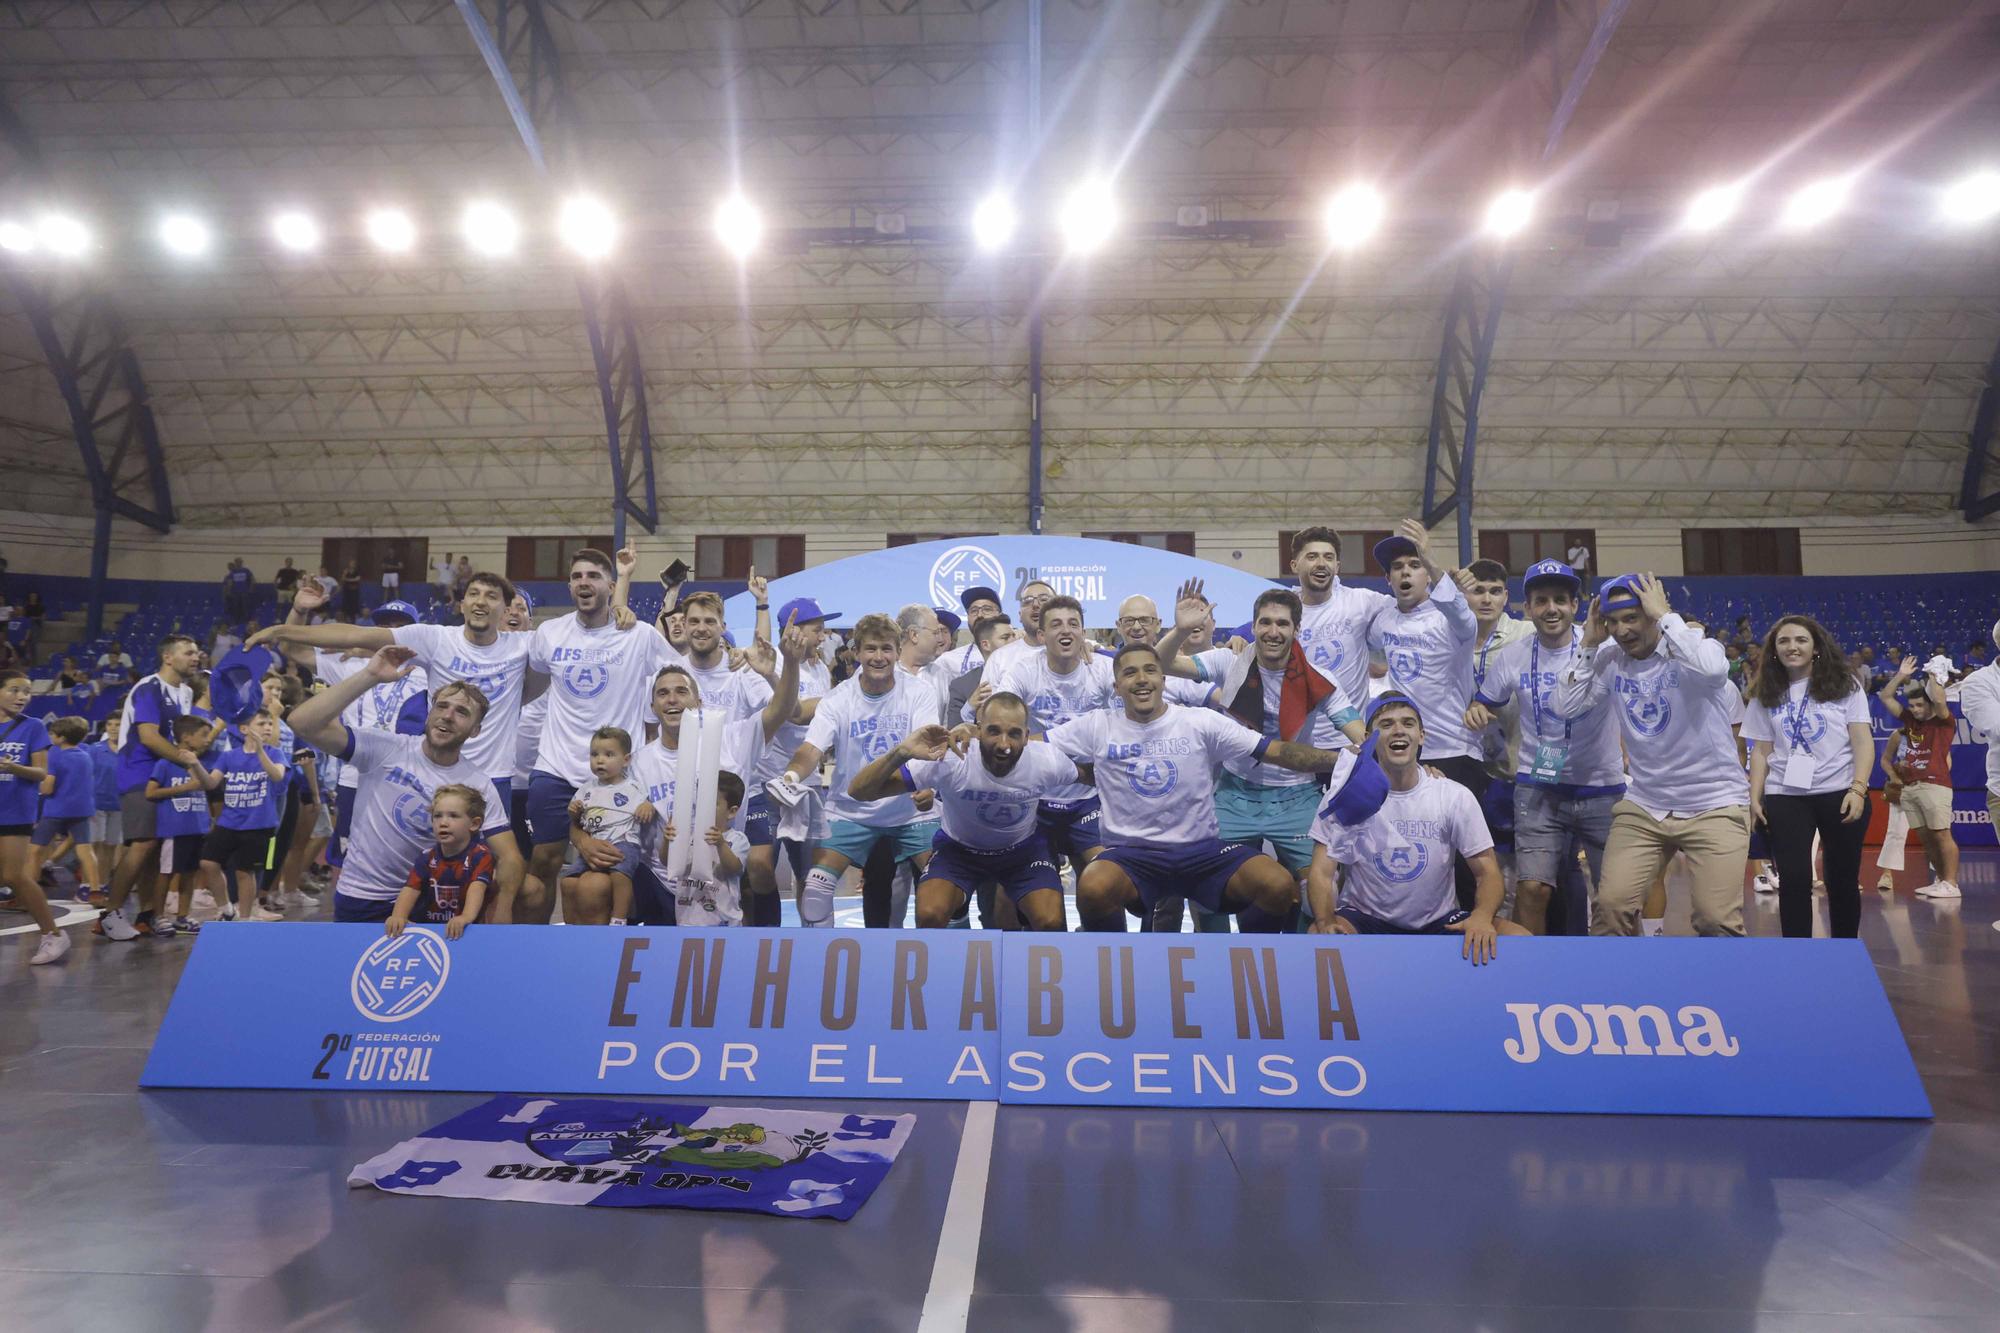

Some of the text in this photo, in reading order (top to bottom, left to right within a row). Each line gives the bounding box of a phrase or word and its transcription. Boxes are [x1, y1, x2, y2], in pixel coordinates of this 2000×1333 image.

[1041, 564, 1106, 573] FEDERACIÓN
[1041, 575, 1107, 601] UTSAL
[1951, 809, 1992, 824] oma
[609, 937, 1360, 1041] ENHORABUENA
[356, 1032, 441, 1043] FEDERACIÓN
[345, 1047, 433, 1082] FUTSAL
[598, 1041, 1368, 1097] POR EL ASCENSO
[484, 1162, 648, 1188] CURVA
